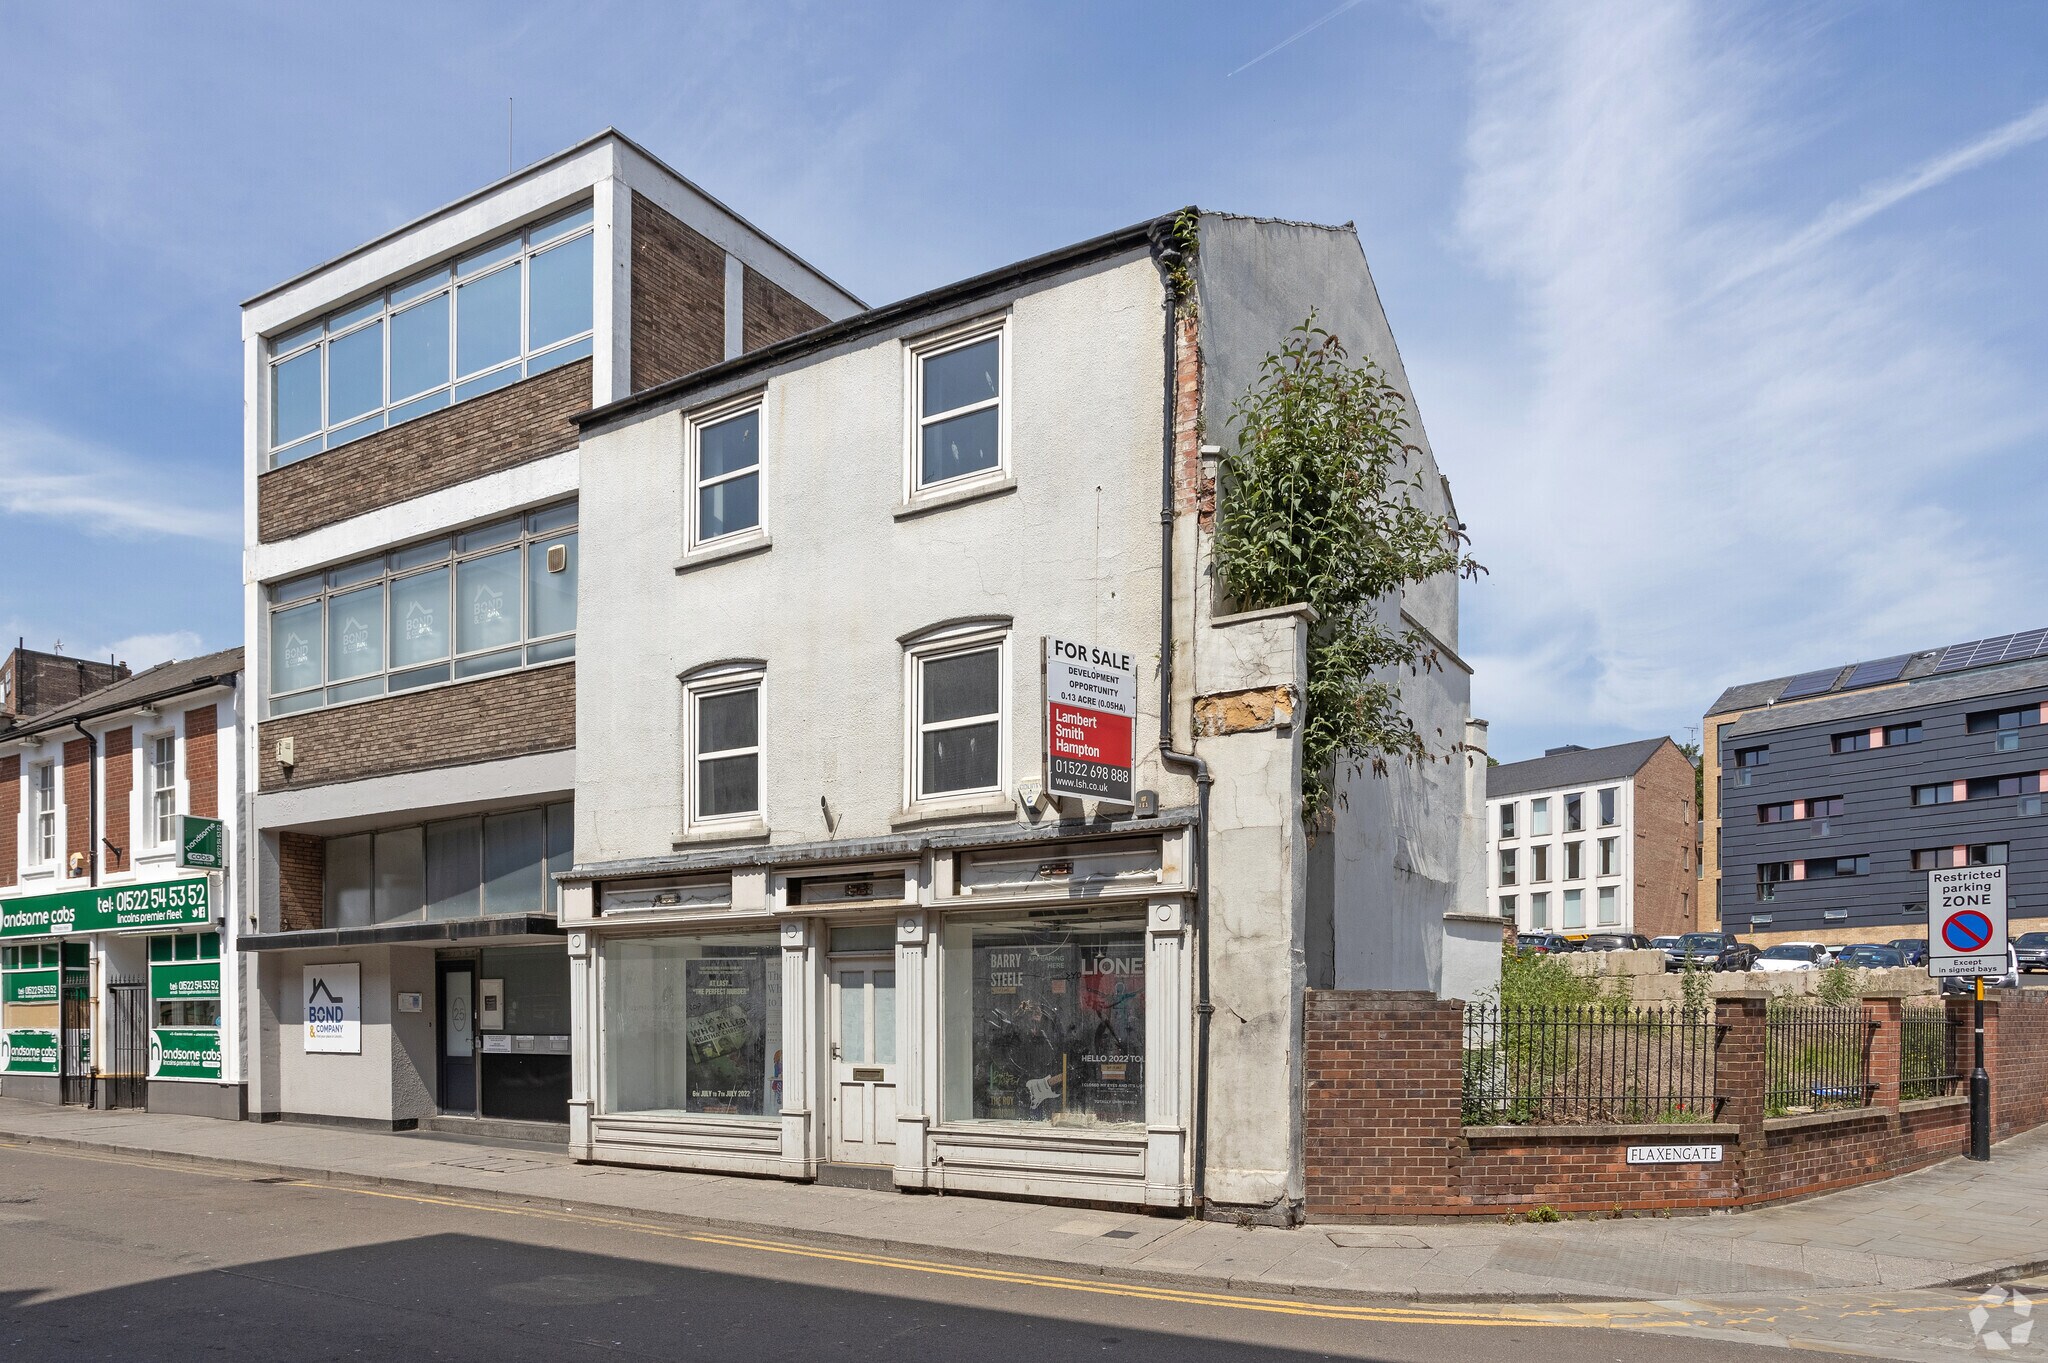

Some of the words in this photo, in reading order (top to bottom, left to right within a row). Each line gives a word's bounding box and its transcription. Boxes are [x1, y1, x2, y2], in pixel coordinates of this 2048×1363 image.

[474, 598, 503, 615] BOND
[406, 615, 433, 631] BOND
[343, 630, 369, 645] BOND
[285, 645, 309, 660] BOND
[1055, 640, 1088, 662] FOR
[1092, 648, 1130, 671] SALE
[1068, 666, 1120, 685] DEVELOPMENT
[1069, 680, 1119, 697] OPPORTUNITY
[1061, 691, 1076, 702] 0.13
[1077, 695, 1097, 706] ACRE
[1098, 699, 1126, 713] (0.05HA)
[1055, 708, 1097, 729] Lambert
[1055, 724, 1085, 741] Smith
[1055, 738, 1100, 758] Hampton
[1055, 759, 1088, 777] 01522
[1090, 766, 1109, 780] 698
[1110, 769, 1129, 783] 888
[1055, 777, 1108, 793] www.lsh.co.uk
[185, 823, 215, 851] handsome
[1934, 869, 2001, 883] Restricted
[1942, 882, 1992, 895] parking
[97, 896, 114, 914] tel:
[116, 889, 149, 912] 01522
[150, 888, 167, 909] 54
[169, 885, 186, 907] 53
[187, 884, 205, 906] 52
[1942, 894, 1992, 908] ZONE
[50, 906, 76, 923] cabs
[117, 913, 140, 924] lincolns
[140, 911, 166, 924] premier
[166, 909, 183, 920] fleet
[991, 953, 1021, 968] BARRY
[1081, 957, 1144, 975] LIONE
[1953, 959, 1982, 967] Except
[1948, 966, 1976, 974] signed
[178, 981, 195, 991] 01522
[194, 980, 202, 990] 54
[203, 980, 210, 990] 53
[211, 980, 219, 990] 52
[991, 971, 1024, 987] STEELE
[309, 1005, 344, 1023] BOND
[452, 1008, 465, 1021] 25
[309, 1025, 316, 1038] &
[316, 1025, 344, 1033] COMPANY
[690, 1025, 716, 1038] WHO
[716, 1017, 747, 1031] KILLED
[41, 1046, 57, 1057] cabs
[201, 1048, 221, 1061] cabs
[1081, 1055, 1107, 1063] HELLO
[1109, 1055, 1129, 1063] 2022
[1631, 1147, 1717, 1161] FLAXENGATE
